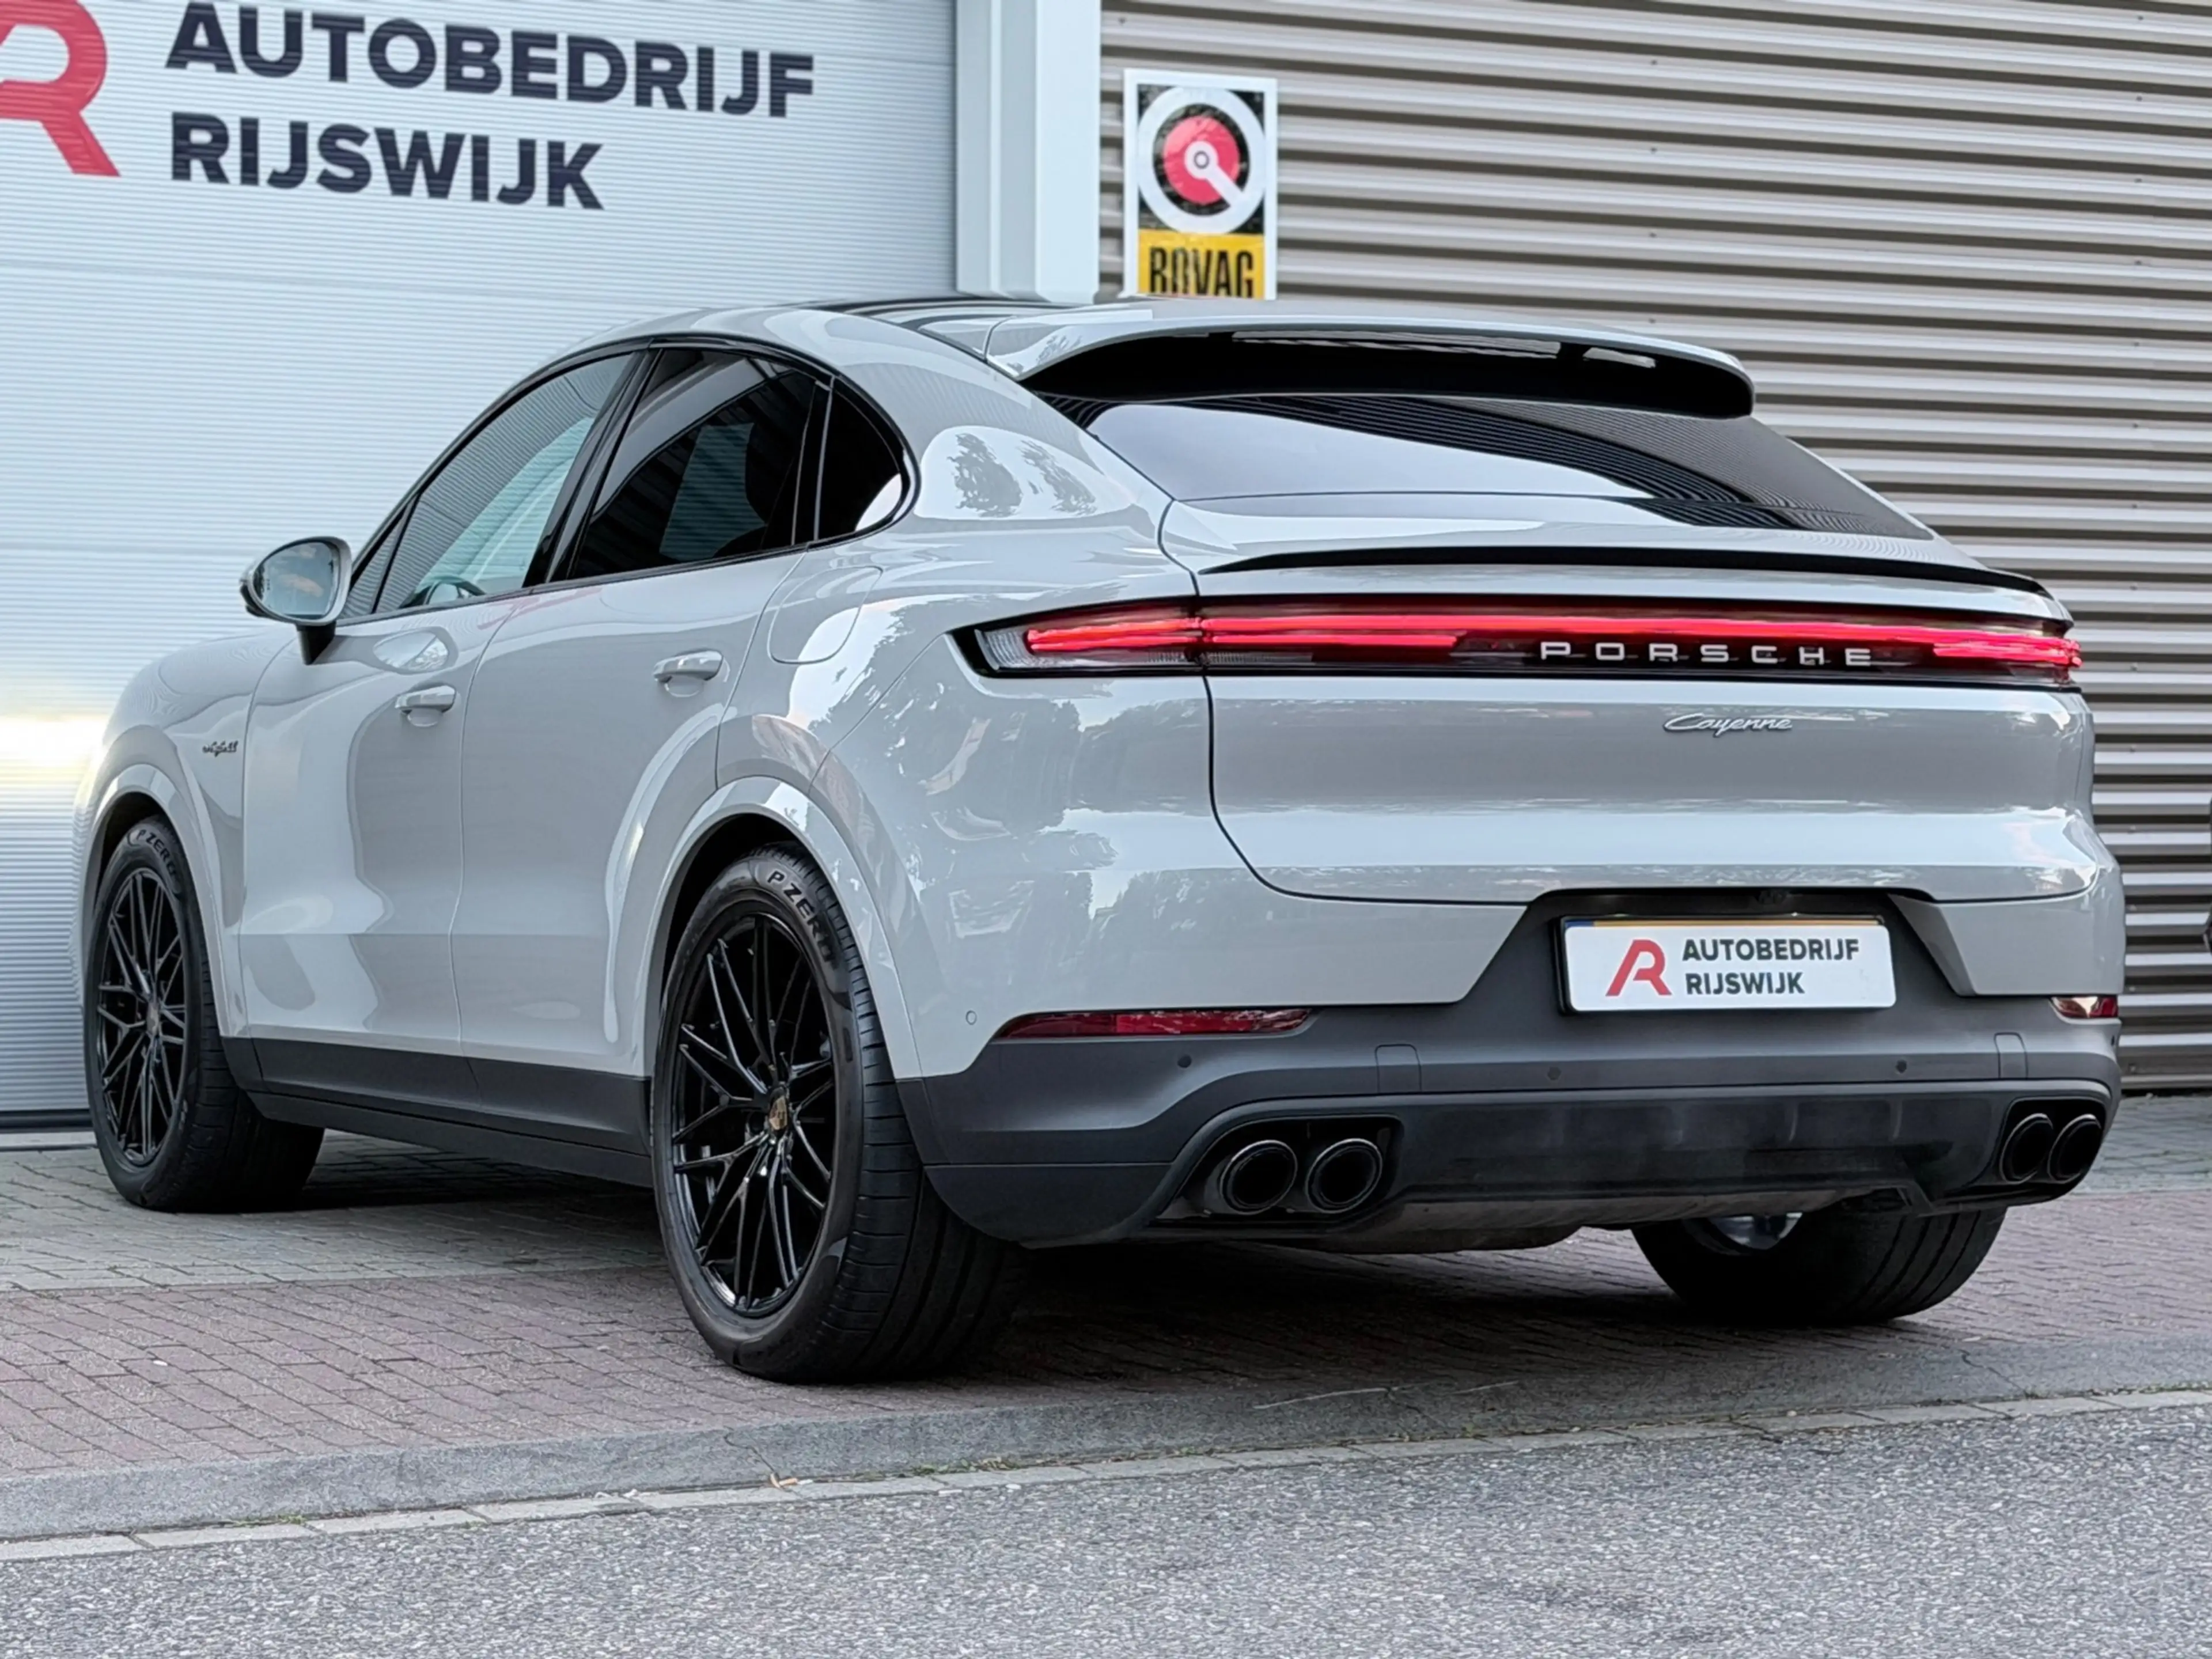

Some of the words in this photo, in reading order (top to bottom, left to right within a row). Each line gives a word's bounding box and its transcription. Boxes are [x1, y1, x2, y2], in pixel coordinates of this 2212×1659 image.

[166, 2, 814, 118] AUTOBEDRIJF
[172, 112, 605, 210] RIJSWIJK
[1149, 247, 1254, 298] BOVAG
[1540, 642, 1871, 666] PORSCHE
[1663, 713, 1793, 737] Cayenne
[767, 870, 785, 884] P
[1682, 938, 1859, 961] AUTOBEDRIJF
[1687, 972, 1805, 995] RIJSWIJK
